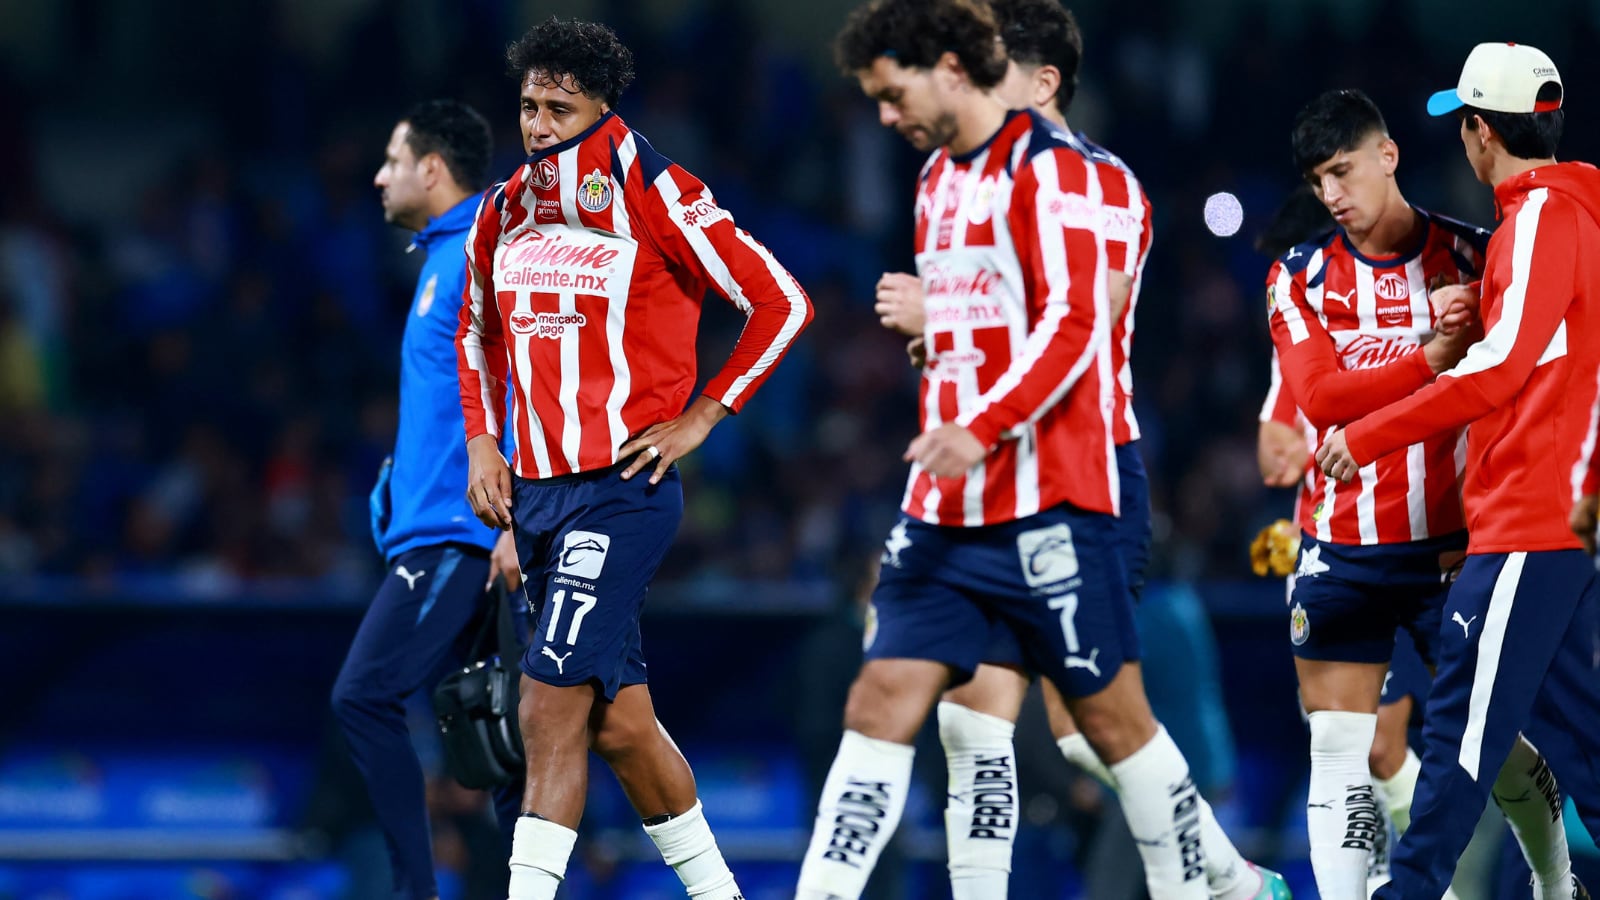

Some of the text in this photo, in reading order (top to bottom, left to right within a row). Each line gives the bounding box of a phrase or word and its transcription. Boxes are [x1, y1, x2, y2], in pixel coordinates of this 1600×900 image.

[500, 228, 619, 269] Caliente
[504, 267, 608, 291] caliente.mx
[1379, 278, 1406, 298] MG
[538, 314, 584, 325] mercado
[1377, 305, 1409, 315] amazon
[540, 325, 565, 336] pago
[553, 575, 596, 592] caliente.mx
[545, 589, 598, 646] 17
[1047, 592, 1080, 653] 7
[970, 755, 1014, 841] PERDURA
[822, 779, 892, 869] PERDURA
[1340, 784, 1377, 852] PERDURA
